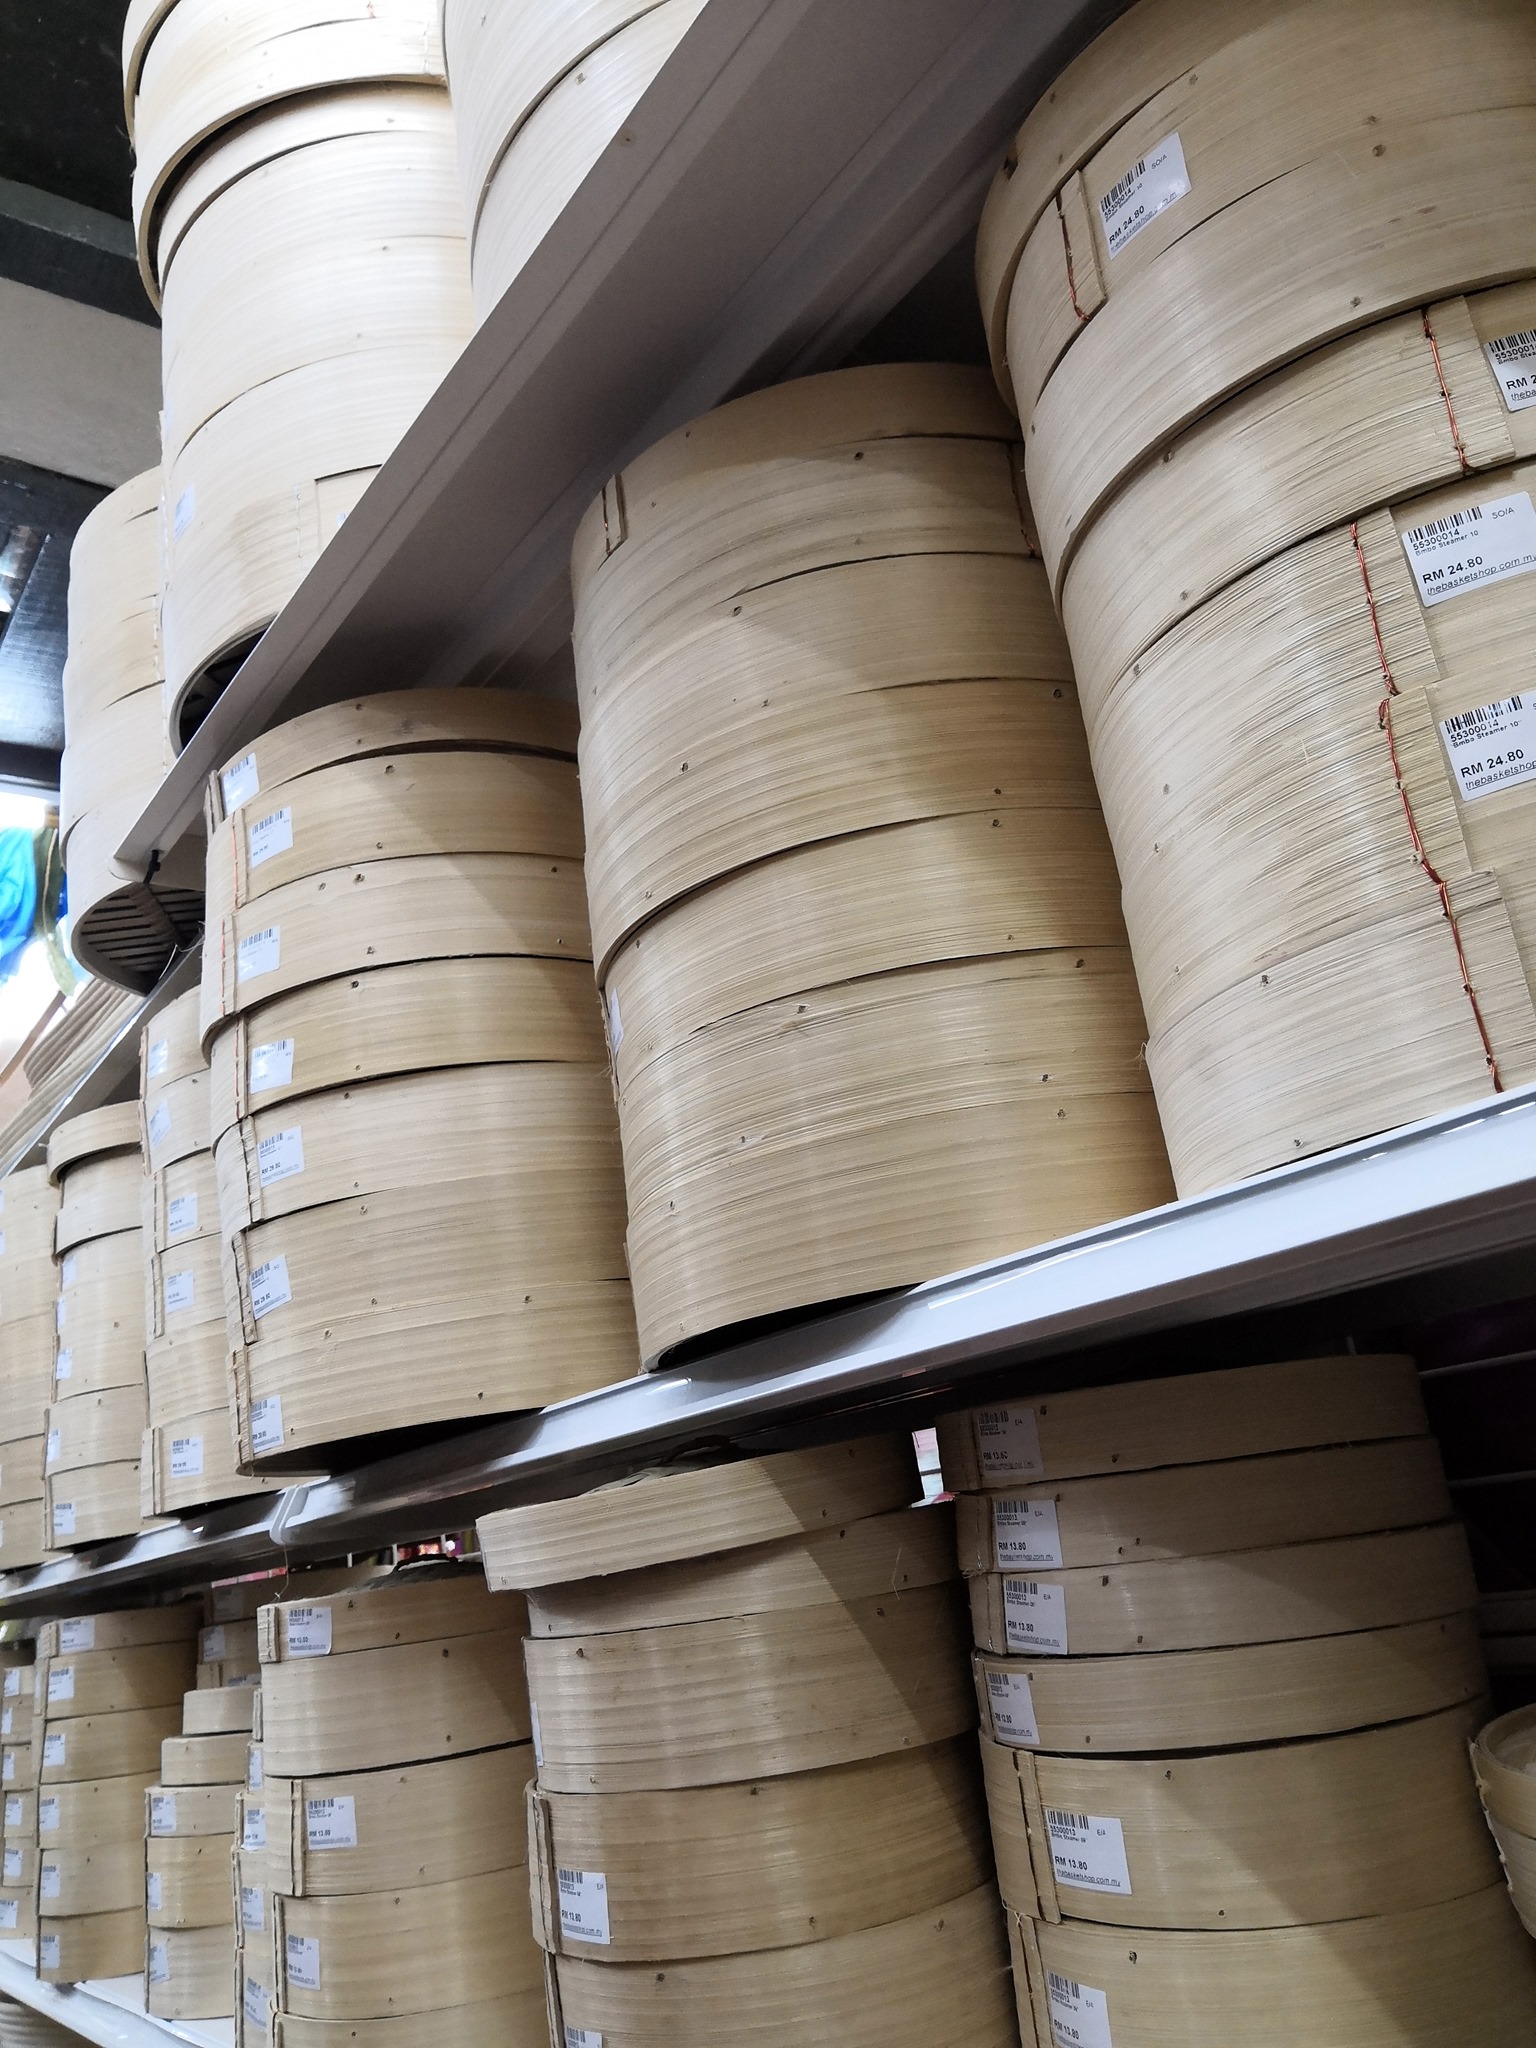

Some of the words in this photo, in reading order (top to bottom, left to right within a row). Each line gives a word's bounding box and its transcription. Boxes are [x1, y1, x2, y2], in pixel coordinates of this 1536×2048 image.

[1109, 227, 1121, 245] RM
[1122, 205, 1145, 231] 24.80
[1495, 344, 1536, 360] 5530001
[1506, 377, 1528, 390] RM
[1492, 507, 1514, 520] SO/A
[1413, 528, 1460, 551] 55300014
[1439, 534, 1468, 548] Steamer
[1422, 569, 1445, 585] RM
[1447, 556, 1483, 575] 24.80
[1450, 719, 1499, 743] 55300014
[1477, 725, 1507, 739] Steamer
[1461, 762, 1483, 778] RM
[1487, 749, 1524, 769] 24.80
[998, 1542, 1008, 1550] RM
[1010, 1542, 1026, 1550] 13.80
[1008, 1620, 1017, 1629] RM
[1018, 1623, 1034, 1632] 13.80
[1055, 1856, 1066, 1866] RM
[1068, 1859, 1087, 1870] 13.80
